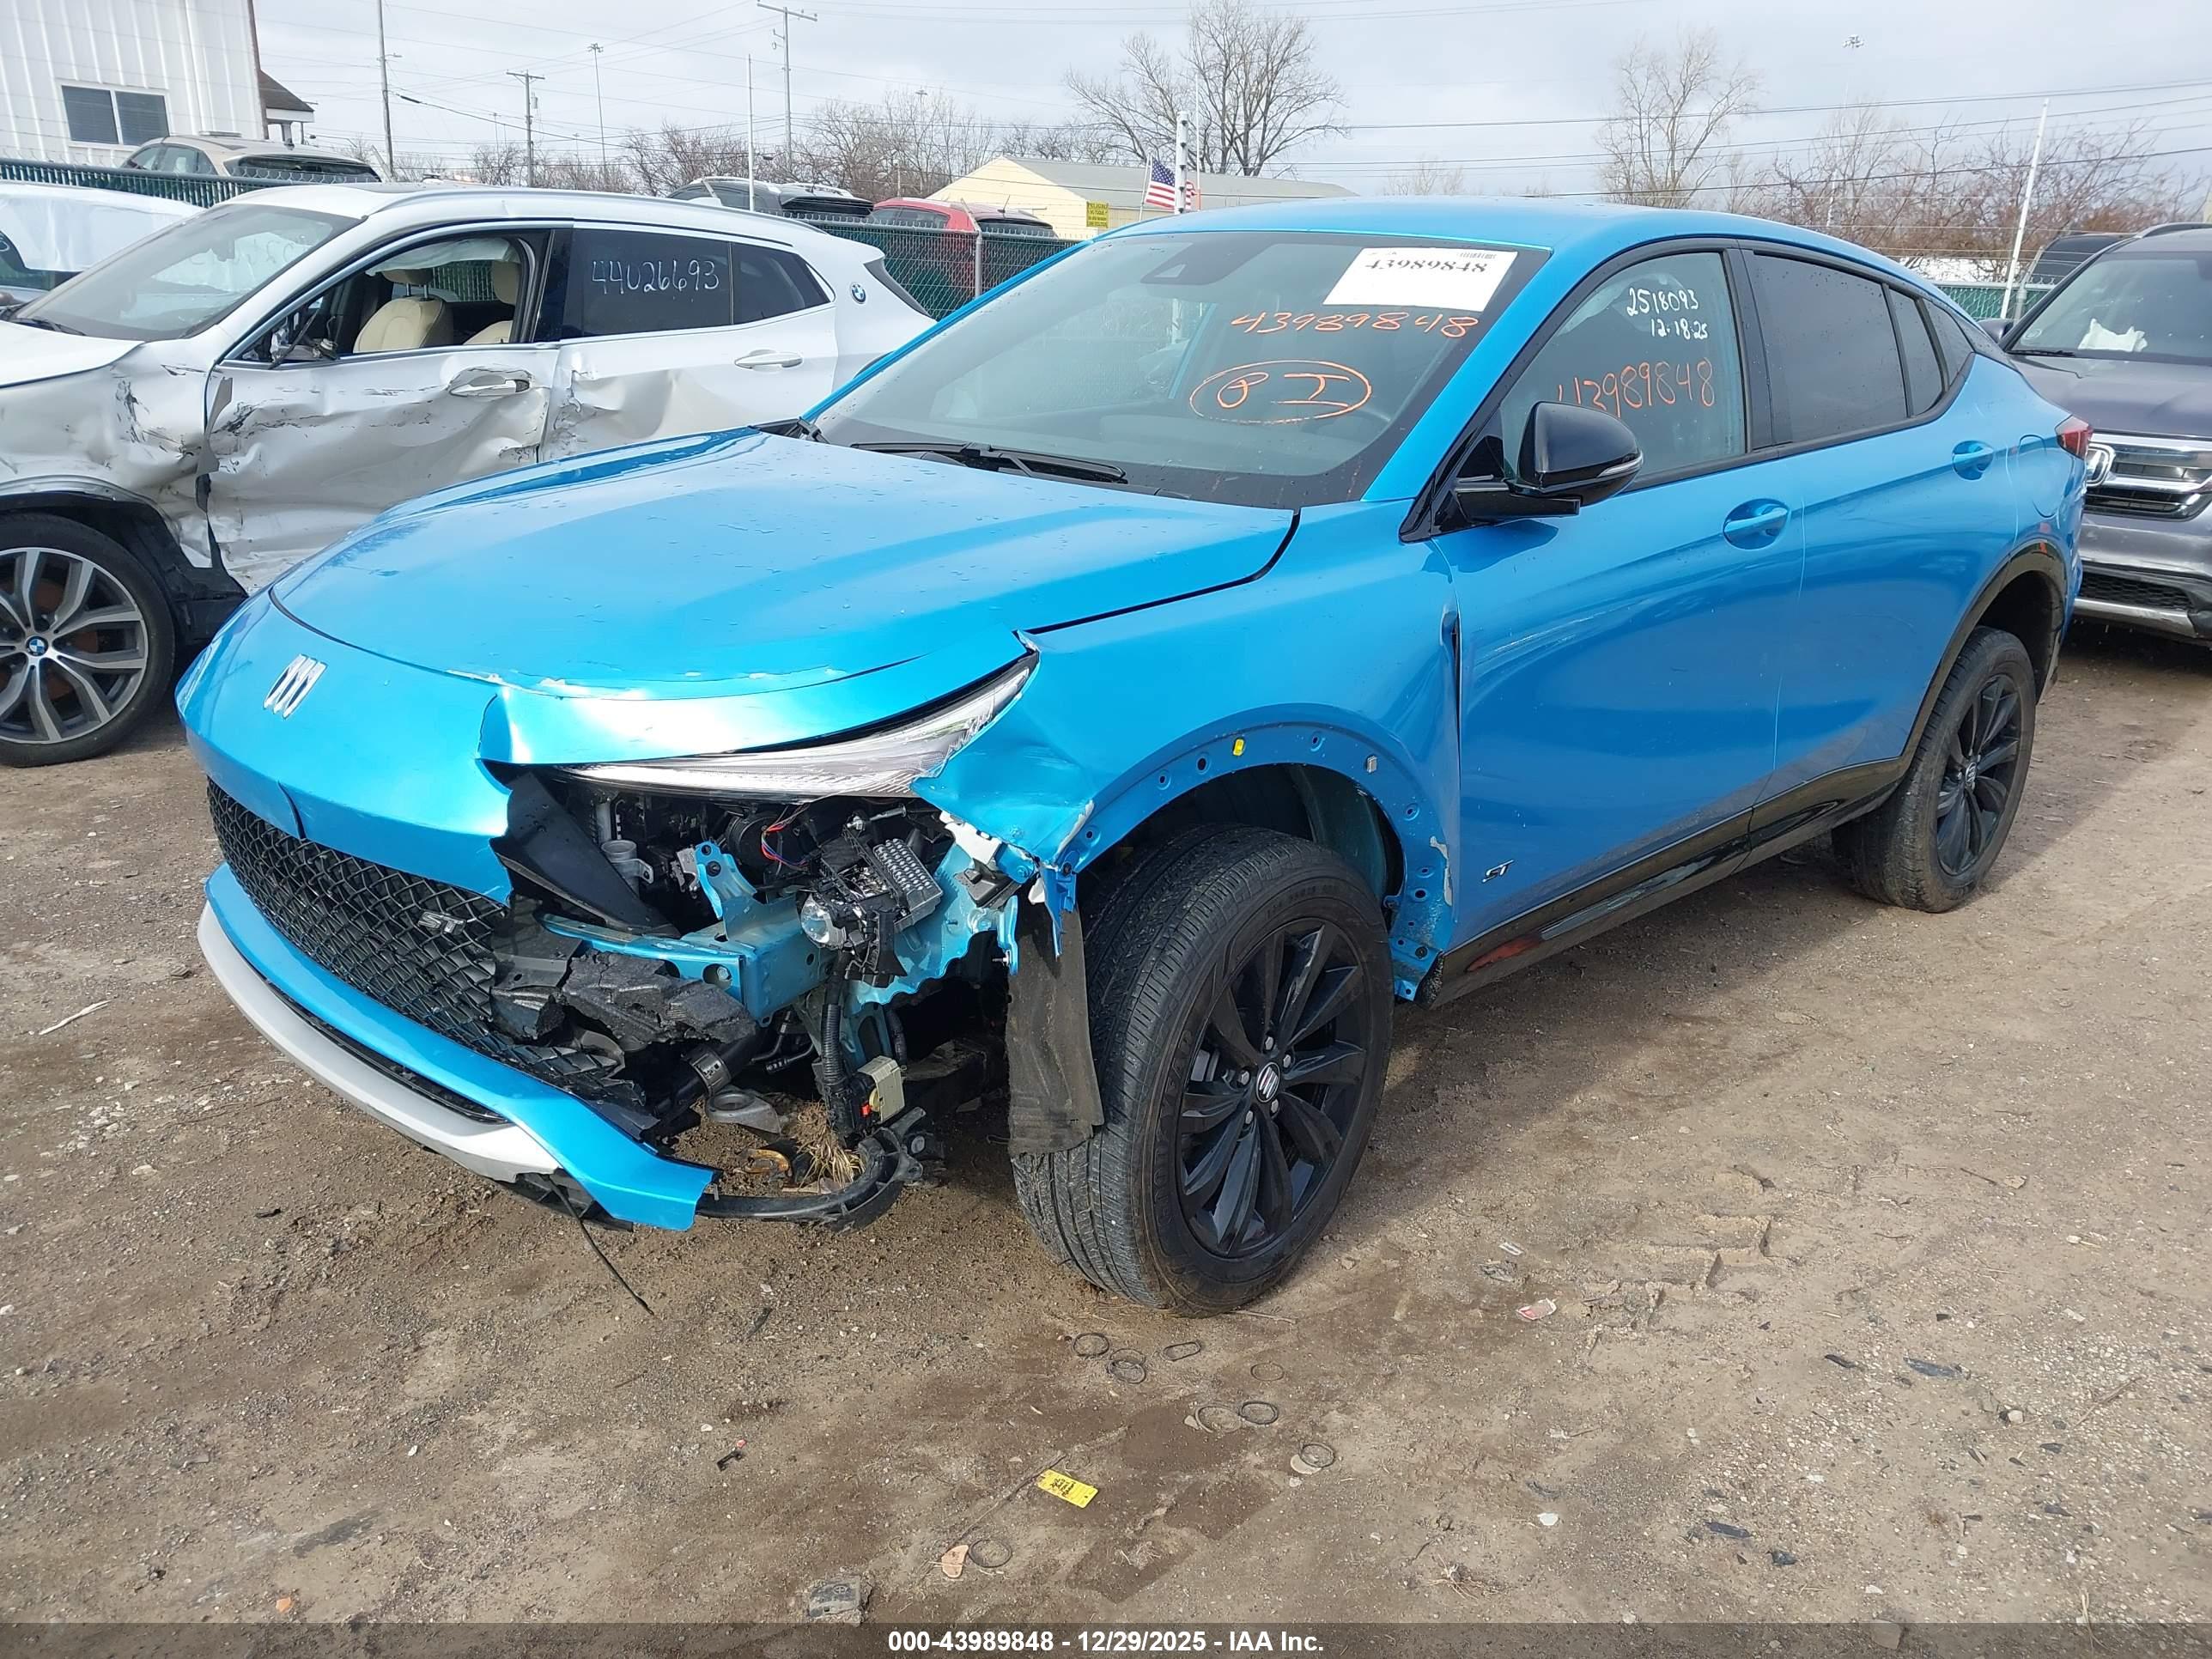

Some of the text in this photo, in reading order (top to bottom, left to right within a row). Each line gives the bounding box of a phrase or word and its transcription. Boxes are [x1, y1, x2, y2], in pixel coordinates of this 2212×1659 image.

[1364, 258, 1488, 273] 43989848
[1626, 287, 1699, 317] 2518093
[1230, 311, 1480, 338] 43989848
[1481, 859, 1515, 884] ST
[417, 911, 466, 935] ST
